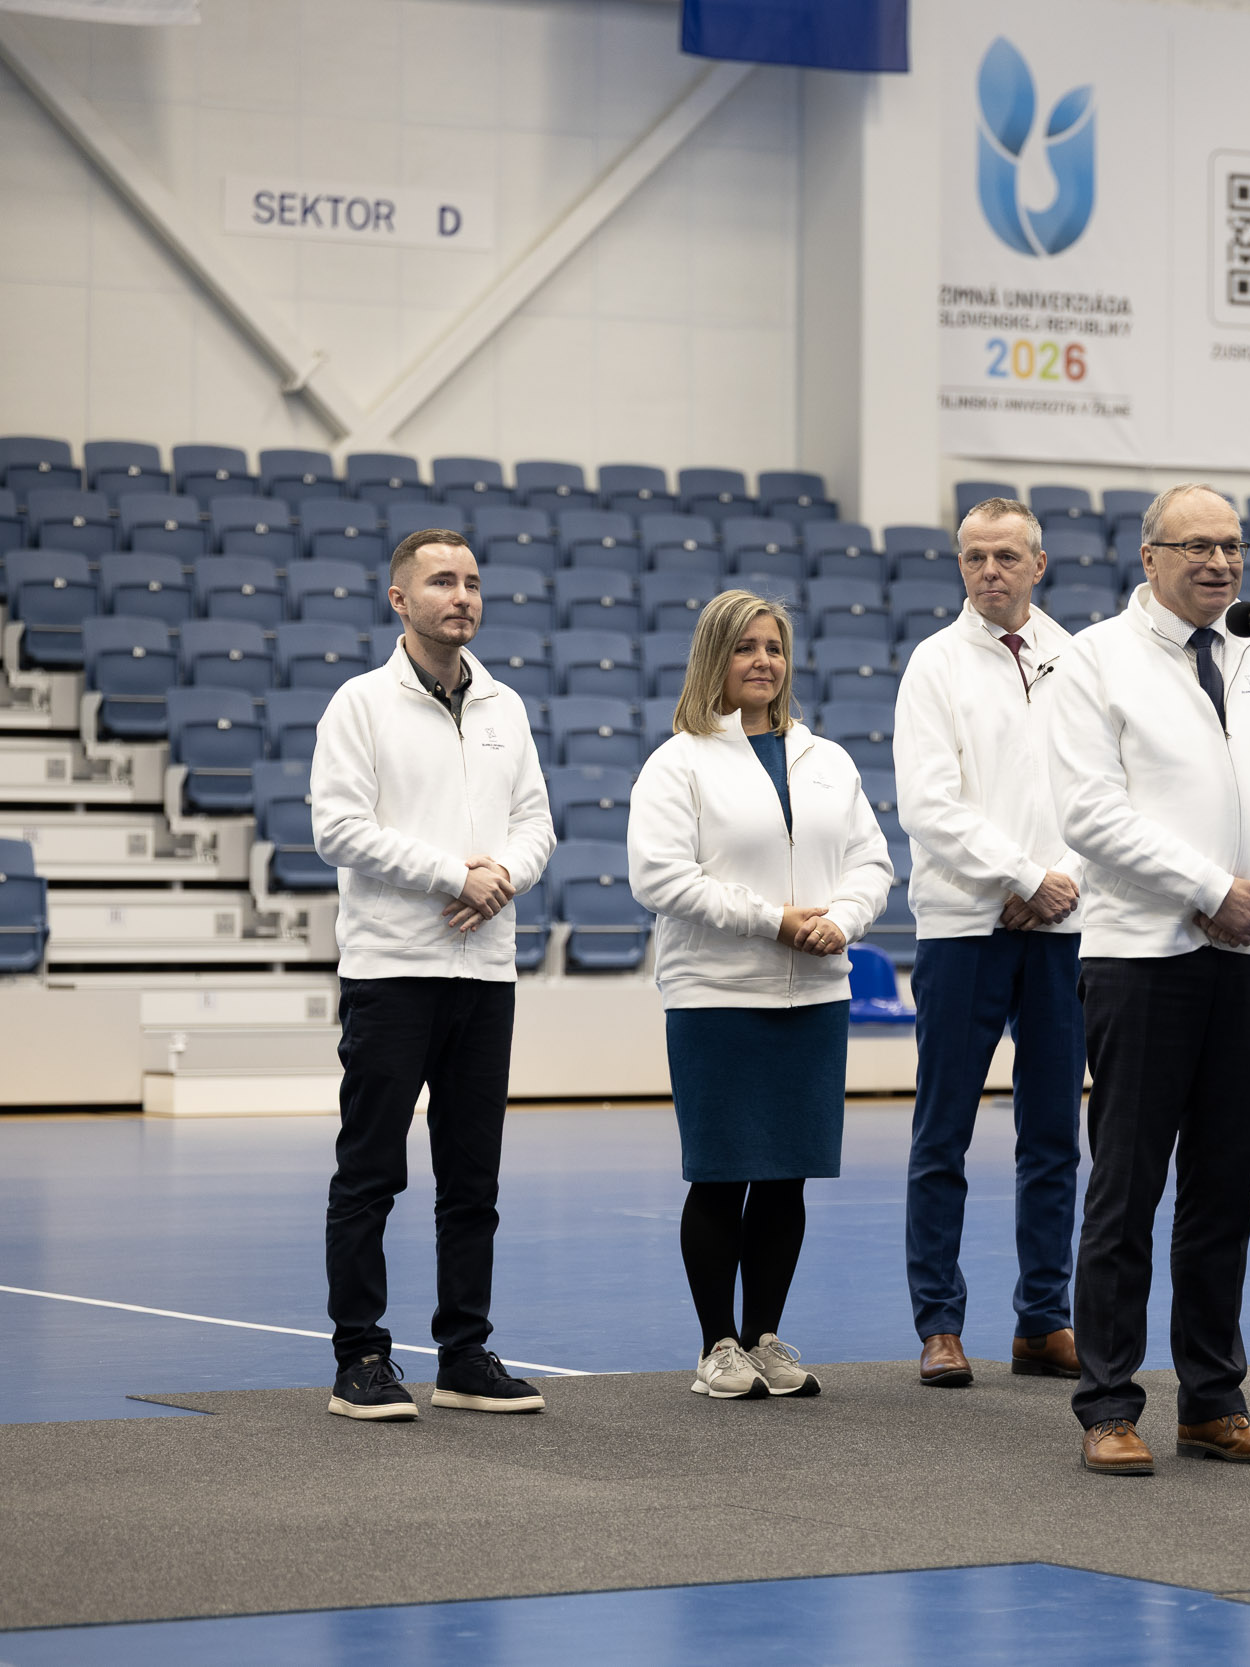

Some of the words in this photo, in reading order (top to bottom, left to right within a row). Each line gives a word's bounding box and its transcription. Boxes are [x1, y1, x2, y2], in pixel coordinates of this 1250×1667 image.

[253, 190, 396, 232] SEKTOR
[438, 204, 462, 236] D
[986, 338, 1086, 381] 2026
